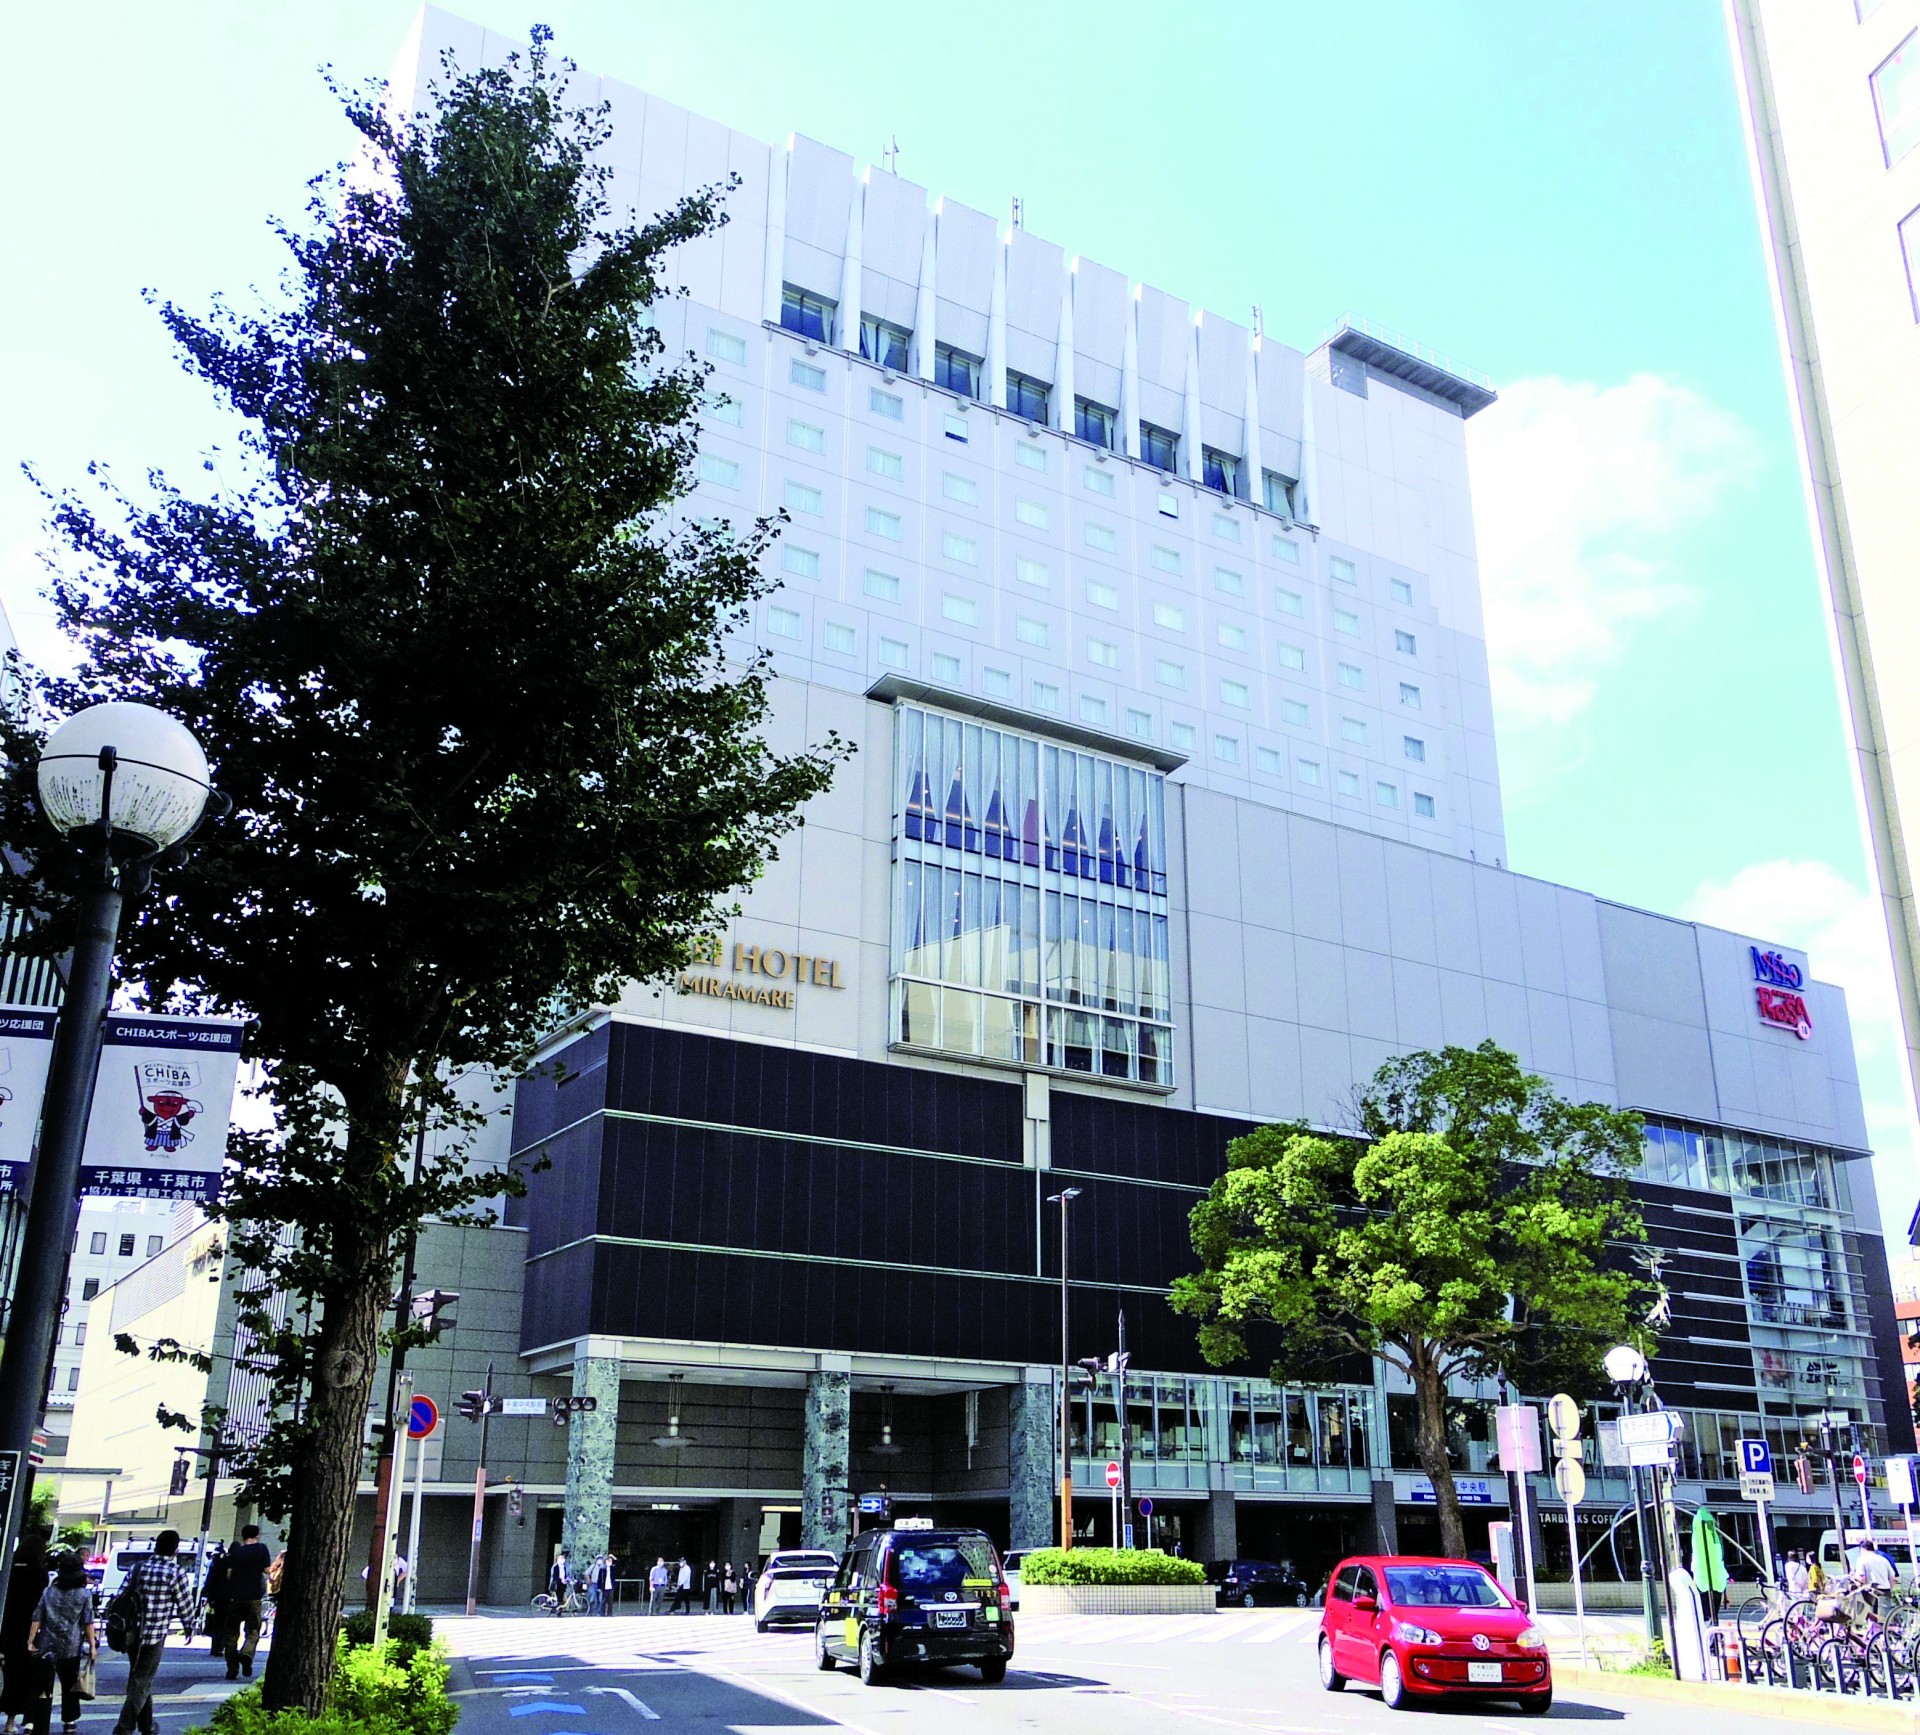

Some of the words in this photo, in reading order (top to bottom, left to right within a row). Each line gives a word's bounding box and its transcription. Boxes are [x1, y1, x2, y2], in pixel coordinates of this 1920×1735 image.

[733, 942, 847, 990] HOTEL
[679, 973, 794, 1010] MIRAMARE
[116, 1026, 232, 1044] CHIBAスポーツ応援団
[145, 1067, 190, 1080] CHIBA
[94, 1170, 207, 1189] 千葉県・千葉市
[1748, 1443, 1765, 1470] P
[973, 1590, 998, 1598] 7127
